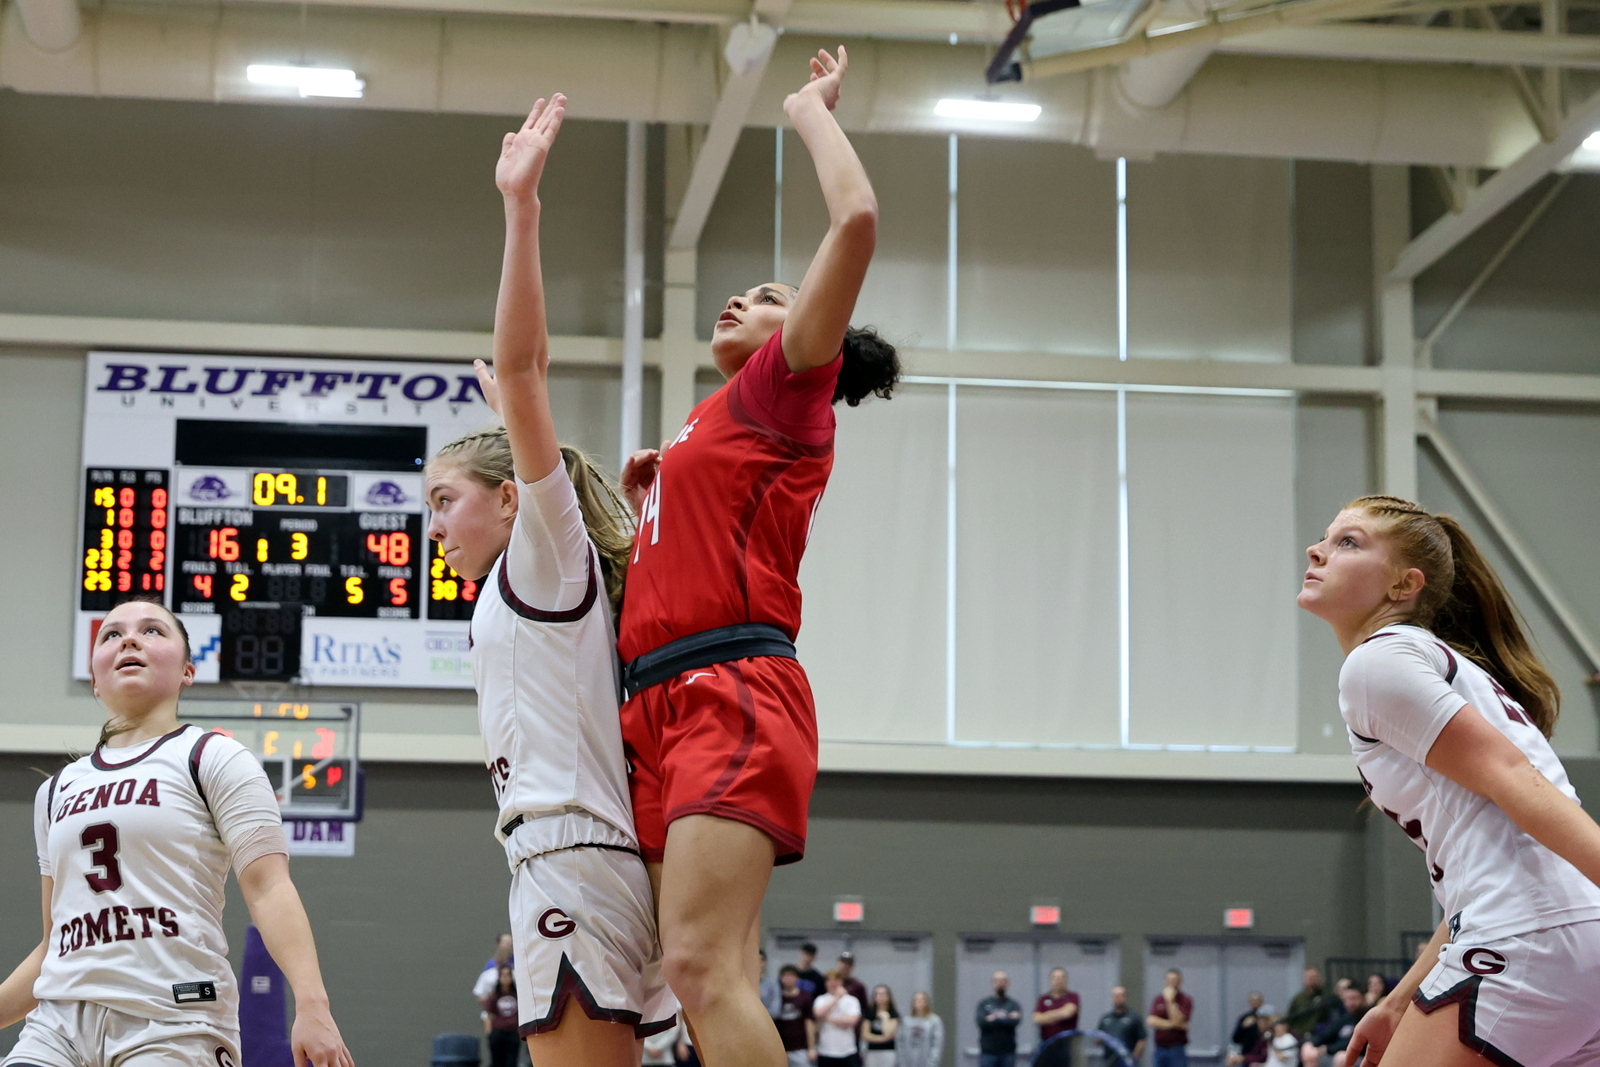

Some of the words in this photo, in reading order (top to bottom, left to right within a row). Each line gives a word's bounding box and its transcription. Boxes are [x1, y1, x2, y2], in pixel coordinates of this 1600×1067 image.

[97, 364, 487, 403] BLUFFTON
[121, 394, 461, 416] UNIVERSITY
[94, 486, 115, 508] 15
[119, 487, 135, 508] 0
[151, 488, 167, 509] 0
[253, 472, 327, 507] 09.1
[106, 508, 115, 526] 1
[118, 508, 134, 528] 0
[151, 509, 167, 529] 0
[178, 509, 254, 527] BLUFFTON
[358, 512, 409, 530] GUEST
[101, 528, 114, 549] 3
[117, 529, 133, 549] 0
[150, 530, 166, 550] 0
[209, 527, 240, 562] 16
[291, 532, 308, 560] 3
[366, 531, 410, 566] 48
[85, 548, 114, 570] 23
[117, 549, 133, 570] 2
[149, 550, 165, 571] 2
[84, 570, 113, 591] 25
[117, 571, 132, 592] 3
[142, 573, 164, 591] 11
[193, 574, 213, 599] 4
[230, 573, 249, 601] 2
[345, 576, 364, 604] 5
[389, 577, 408, 605] 5
[431, 579, 458, 601] 30
[461, 580, 477, 602] 2
[55, 778, 161, 823] GENOA
[79, 820, 124, 895] 3
[58, 905, 180, 958] COMETS
[537, 907, 577, 939] G
[1461, 947, 1507, 975] G
[204, 986, 211, 996] S
